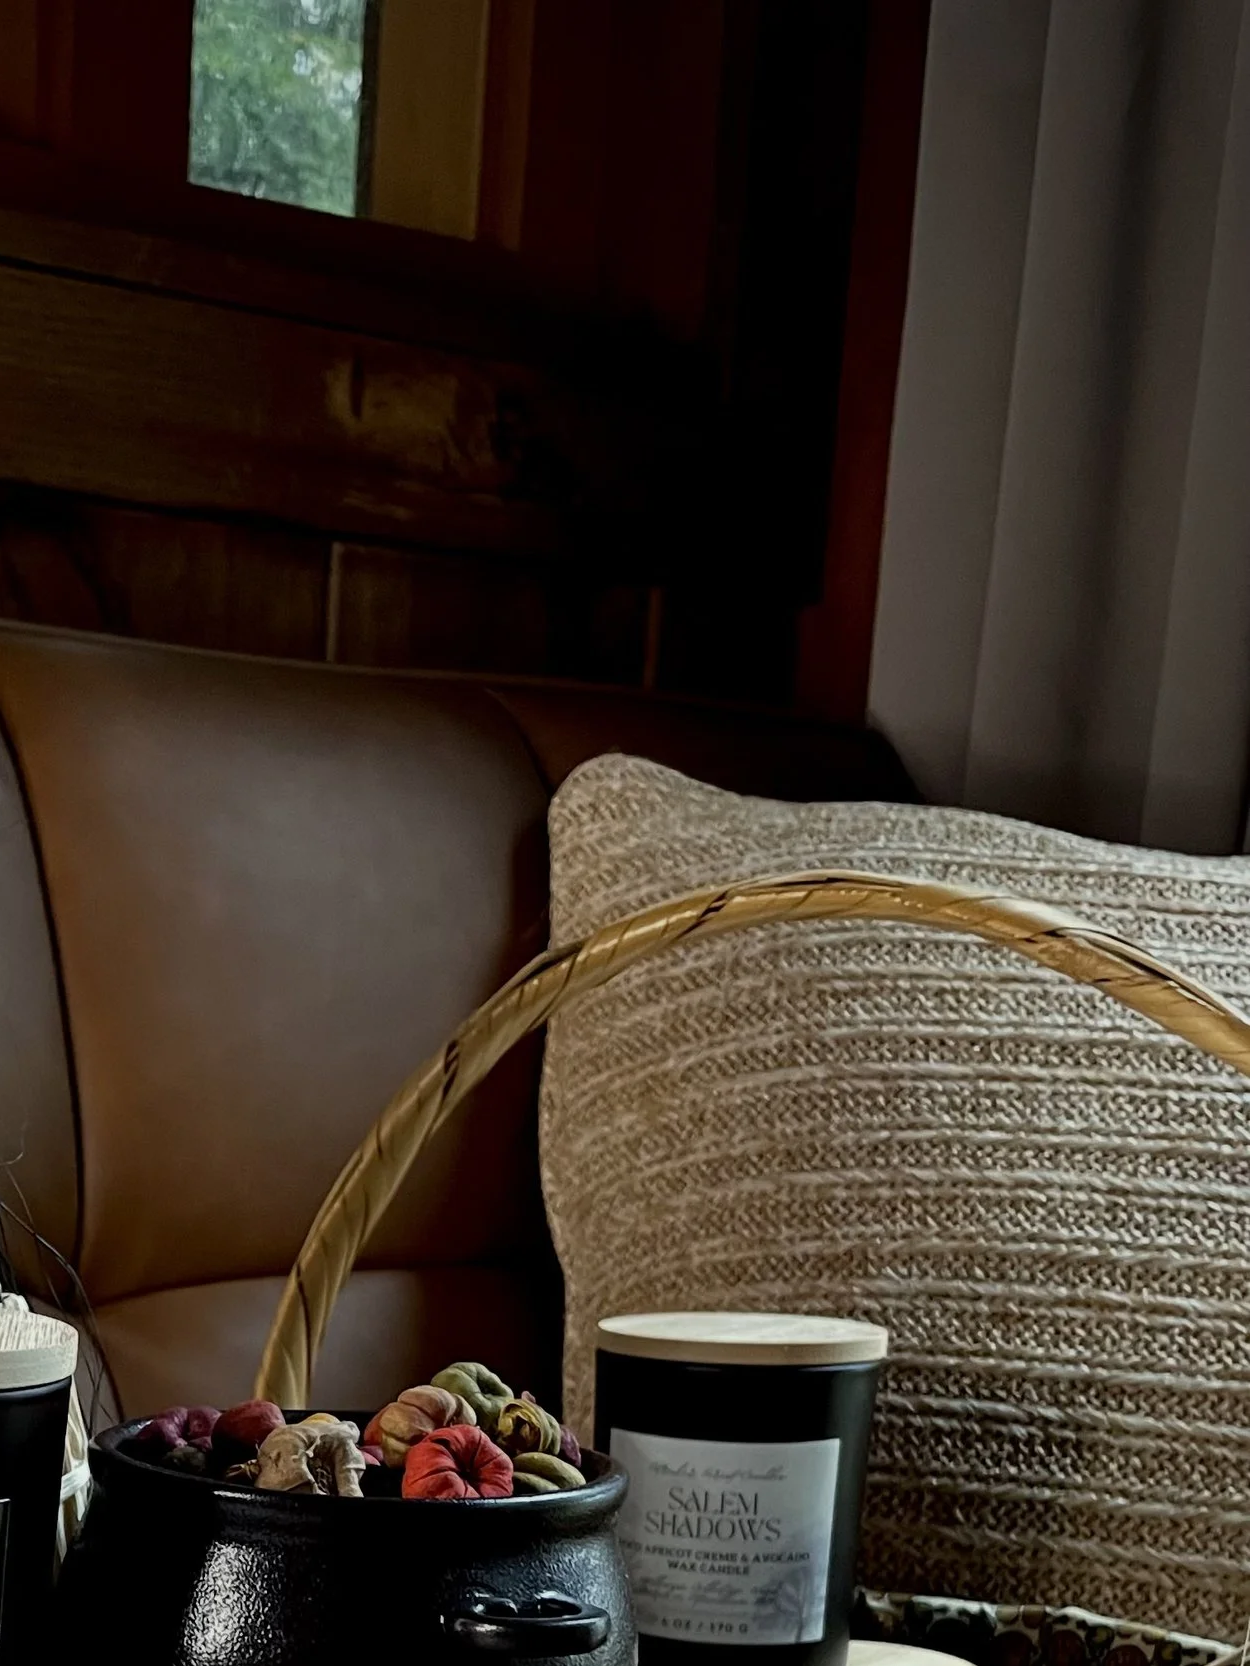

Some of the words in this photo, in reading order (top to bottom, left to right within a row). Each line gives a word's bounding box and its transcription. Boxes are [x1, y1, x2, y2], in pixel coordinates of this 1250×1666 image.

[667, 1486, 759, 1516] SALEM
[644, 1510, 782, 1542] SHADOWS
[667, 1560, 698, 1572] WAX
[700, 1562, 750, 1575] CANDLE
